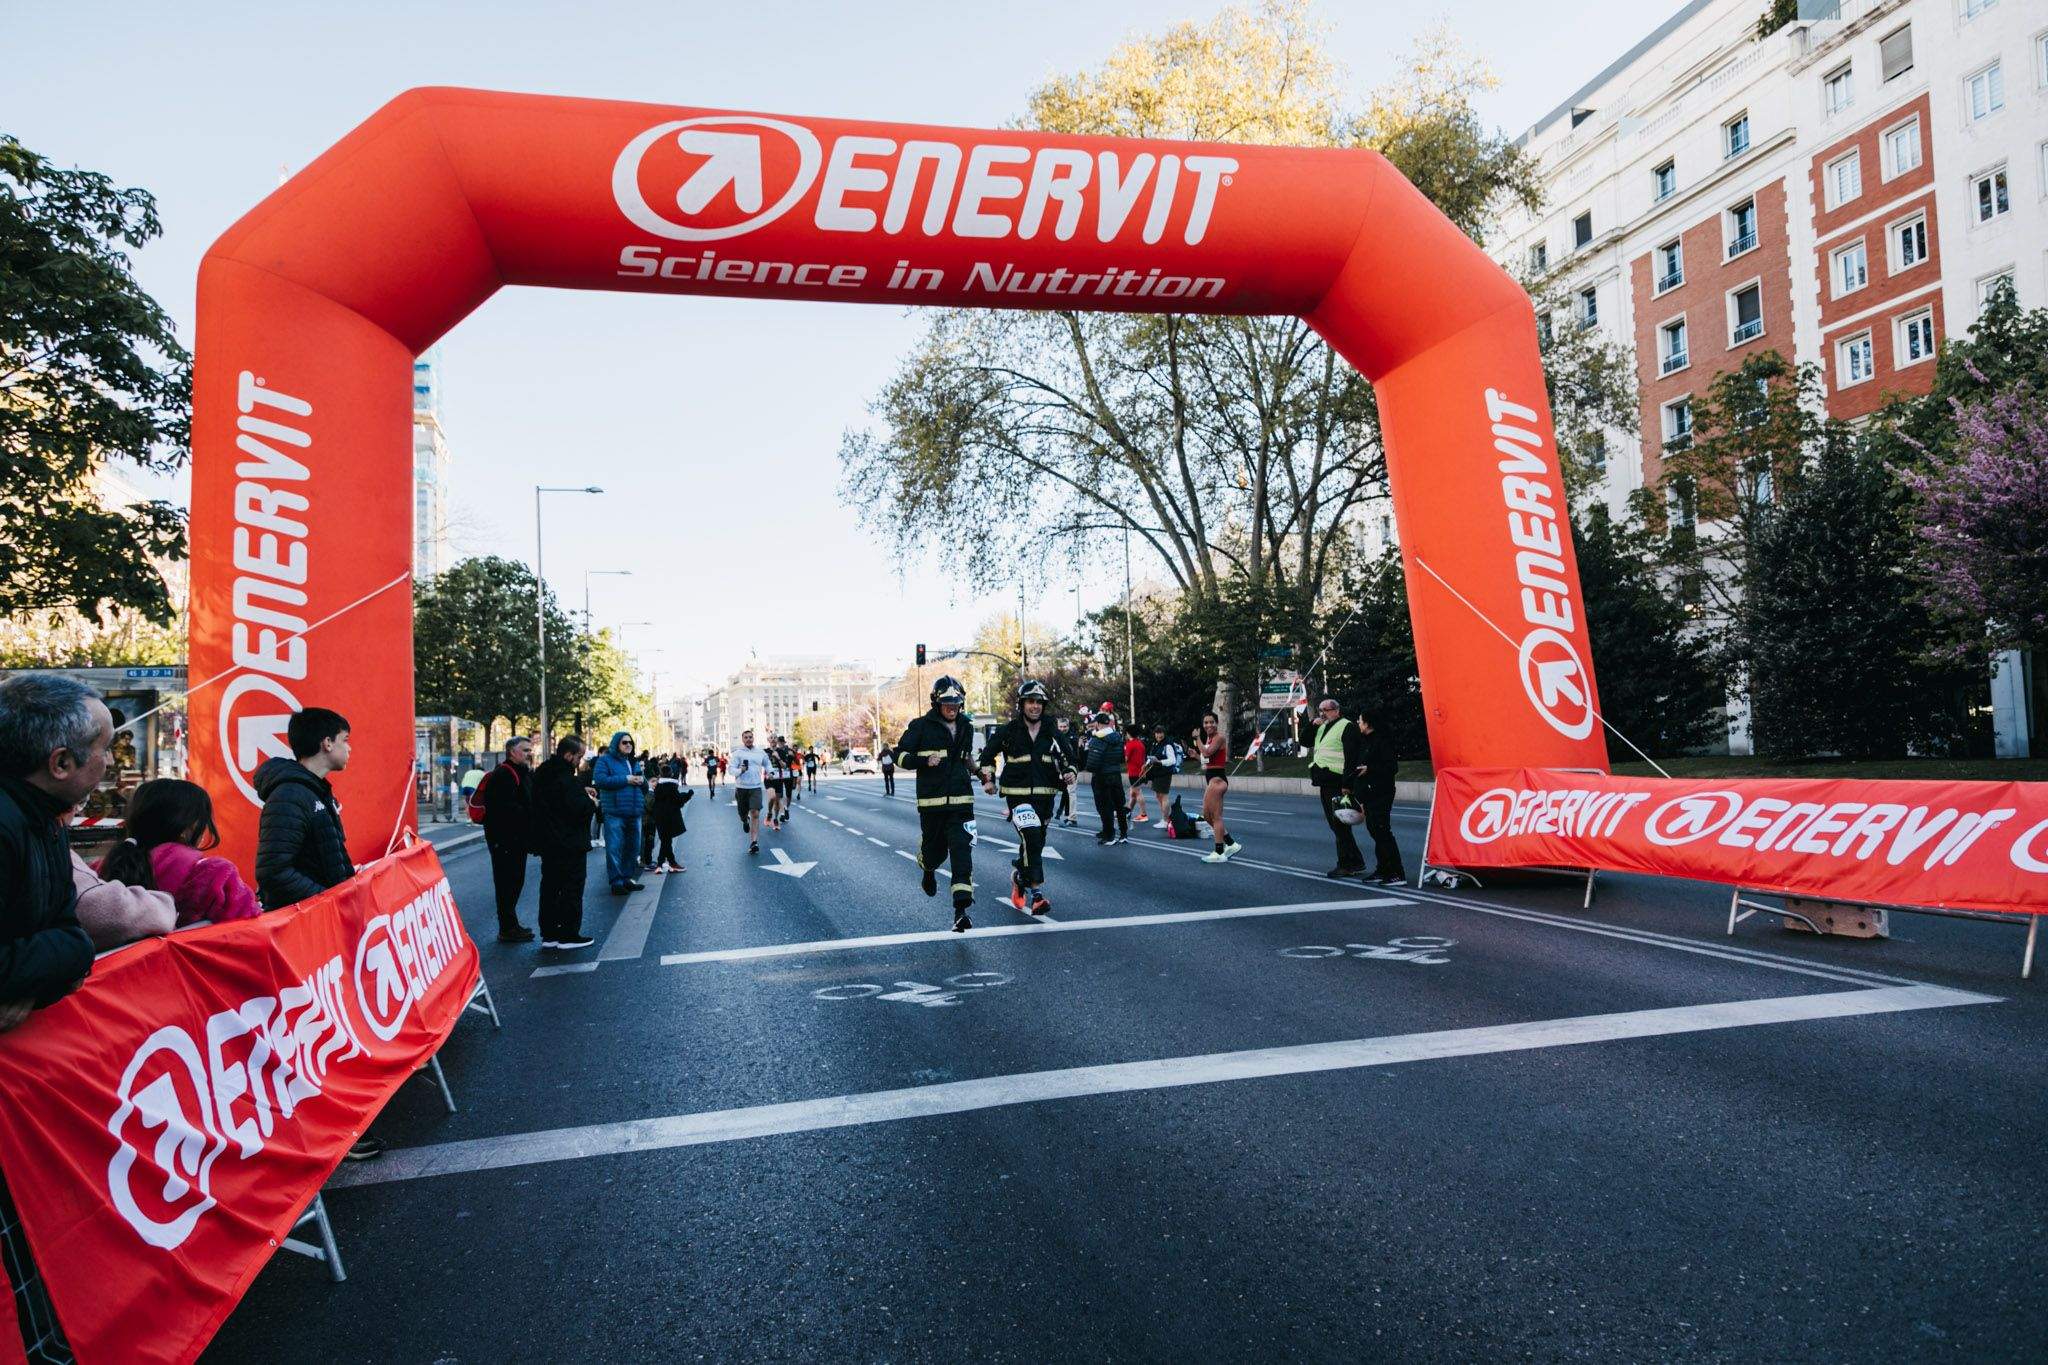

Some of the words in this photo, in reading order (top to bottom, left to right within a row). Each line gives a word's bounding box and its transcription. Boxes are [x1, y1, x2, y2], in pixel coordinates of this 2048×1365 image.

[814, 136, 1239, 246] ENERVIT
[617, 245, 868, 288] Science
[887, 260, 945, 291] in
[963, 262, 1227, 299] Nutrition
[232, 370, 313, 681] ENERVIT
[1485, 388, 1575, 633] ENERVIT
[1508, 789, 1651, 837] ENERVIT
[1718, 797, 2017, 871] ENERVIT
